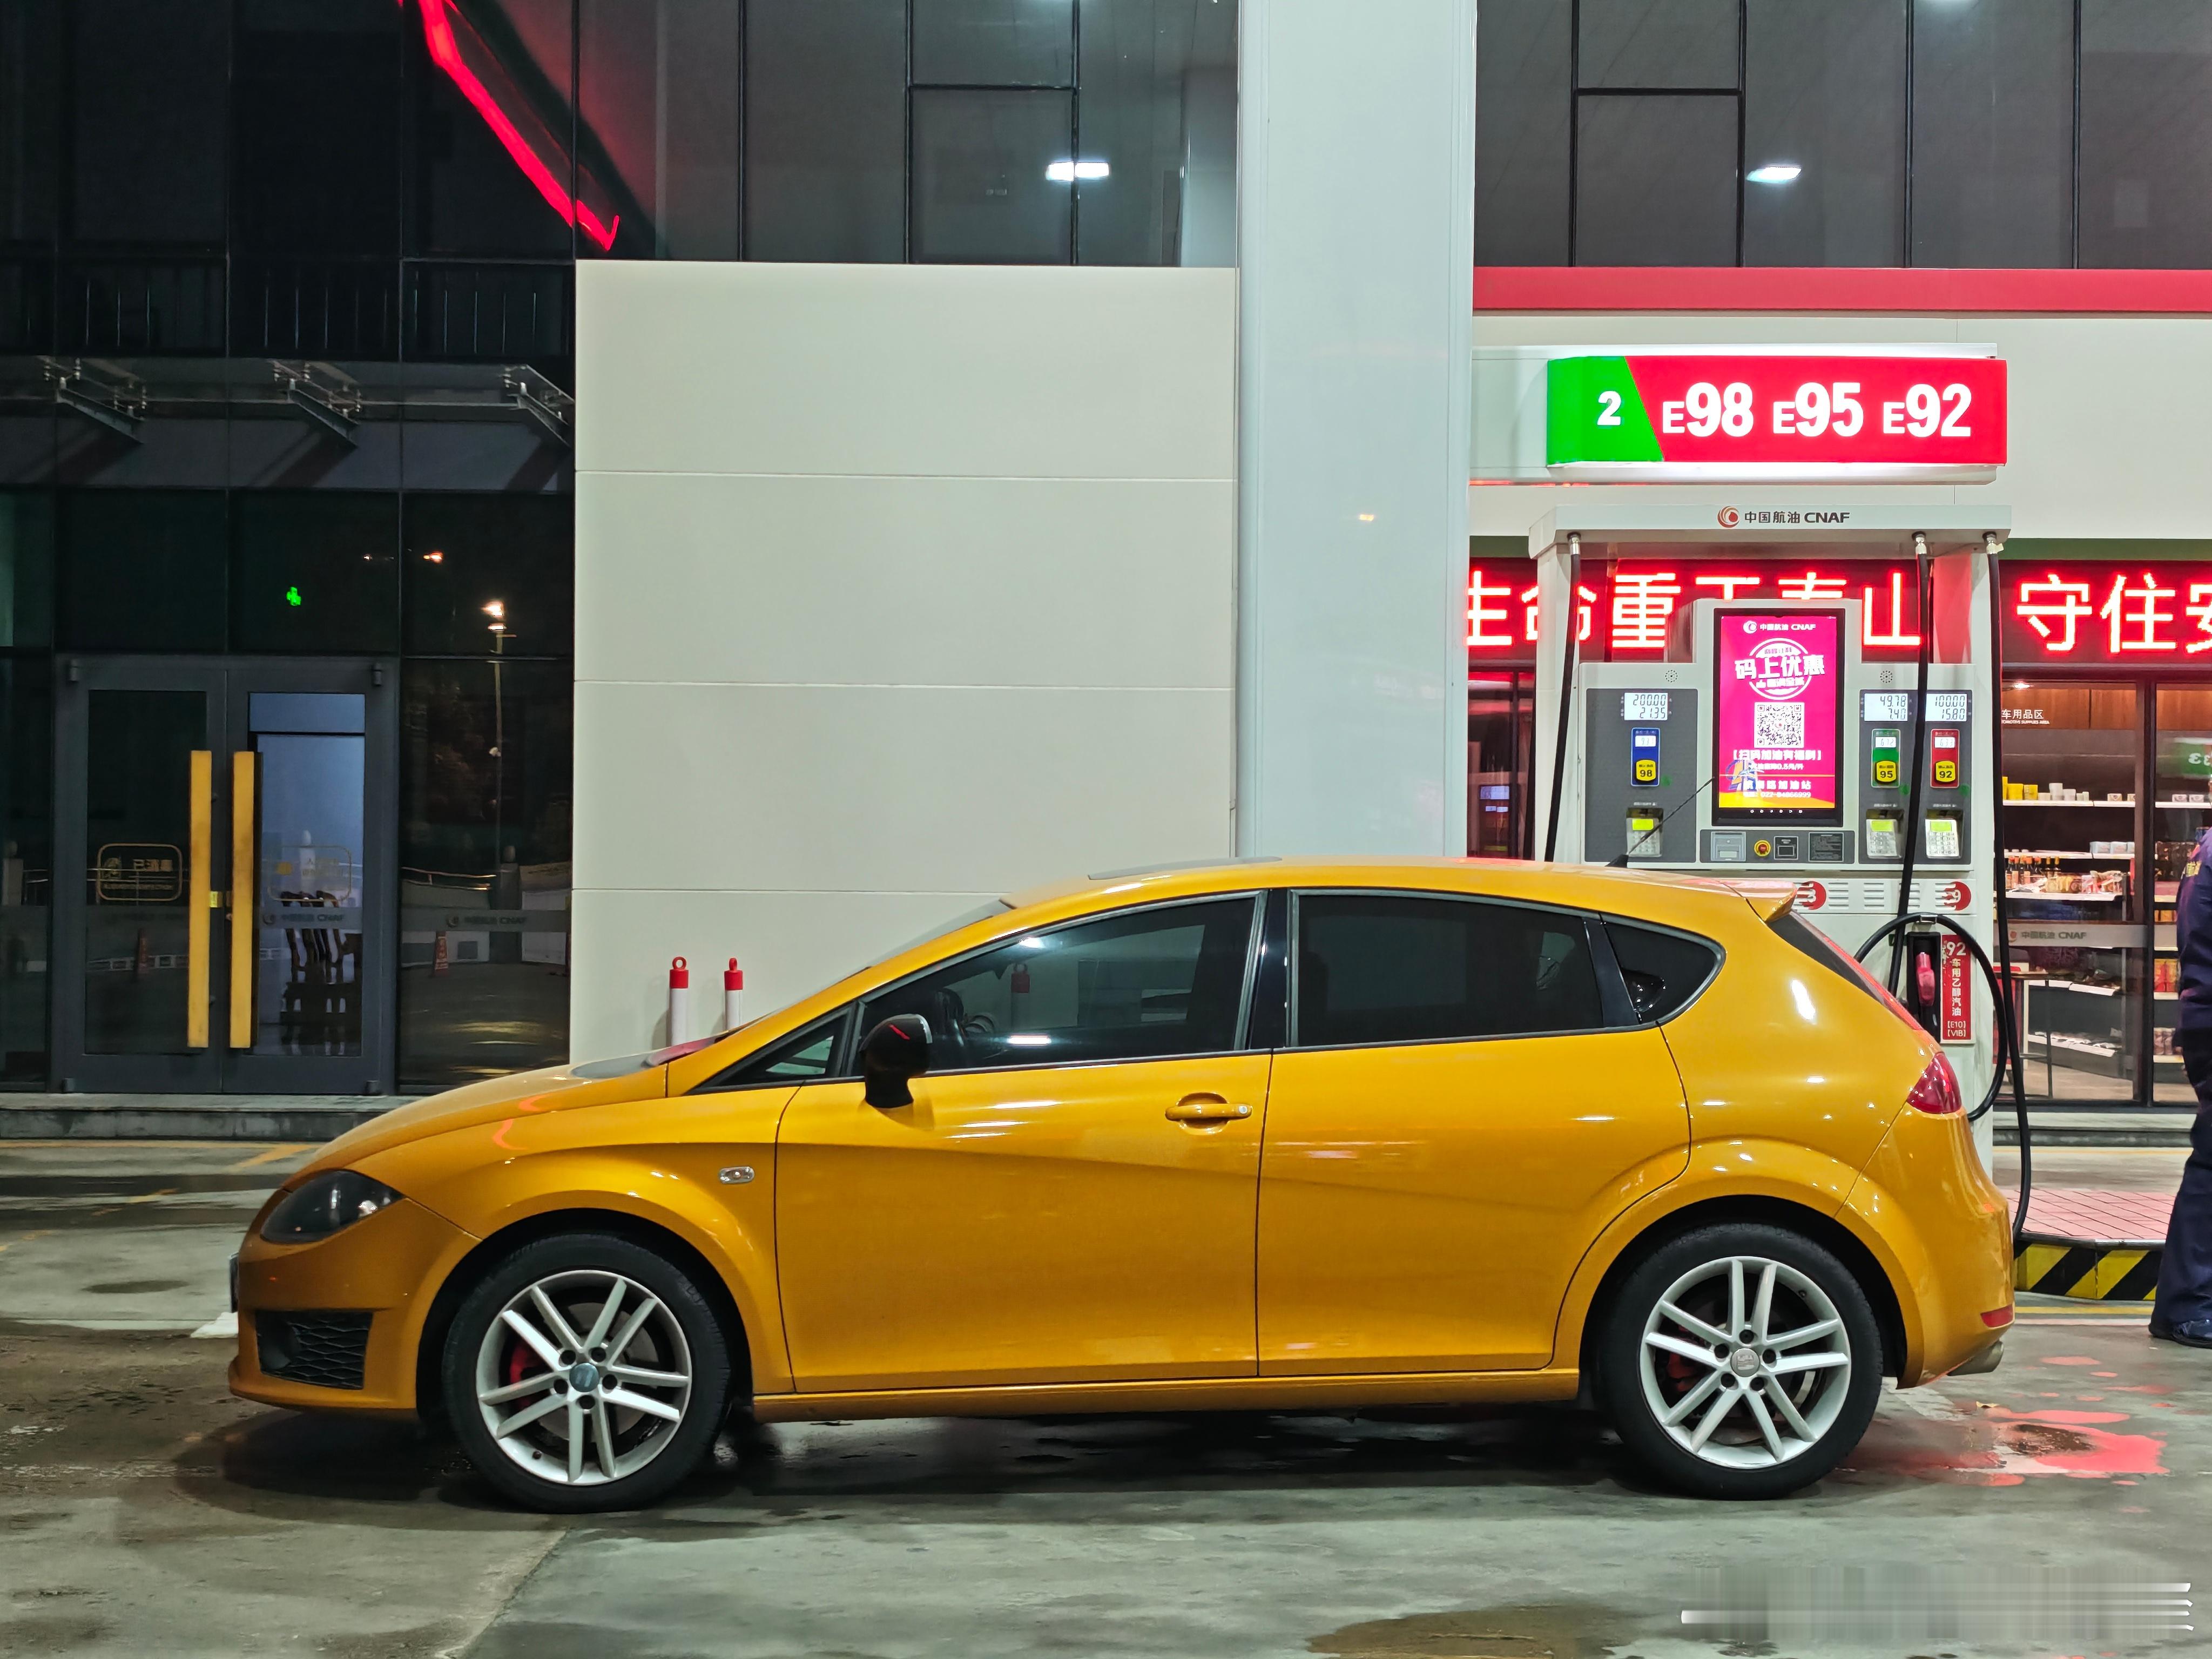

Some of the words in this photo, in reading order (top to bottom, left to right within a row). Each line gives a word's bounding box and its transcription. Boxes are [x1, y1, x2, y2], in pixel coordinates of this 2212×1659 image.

[1597, 390, 1622, 426] 2
[1662, 382, 1754, 437] E98
[1773, 382, 1864, 437] E95
[1883, 383, 1972, 437] E92
[1744, 511, 1800, 524] 中国航油
[1804, 511, 1850, 523] CNAF
[1734, 654, 1825, 679] 码上优惠
[2001, 709, 2044, 719] 车用品区
[1640, 770, 1653, 778] 98
[1939, 771, 1952, 779] 92
[2058, 931, 2087, 939] CNAF
[1946, 941, 1966, 956] 92
